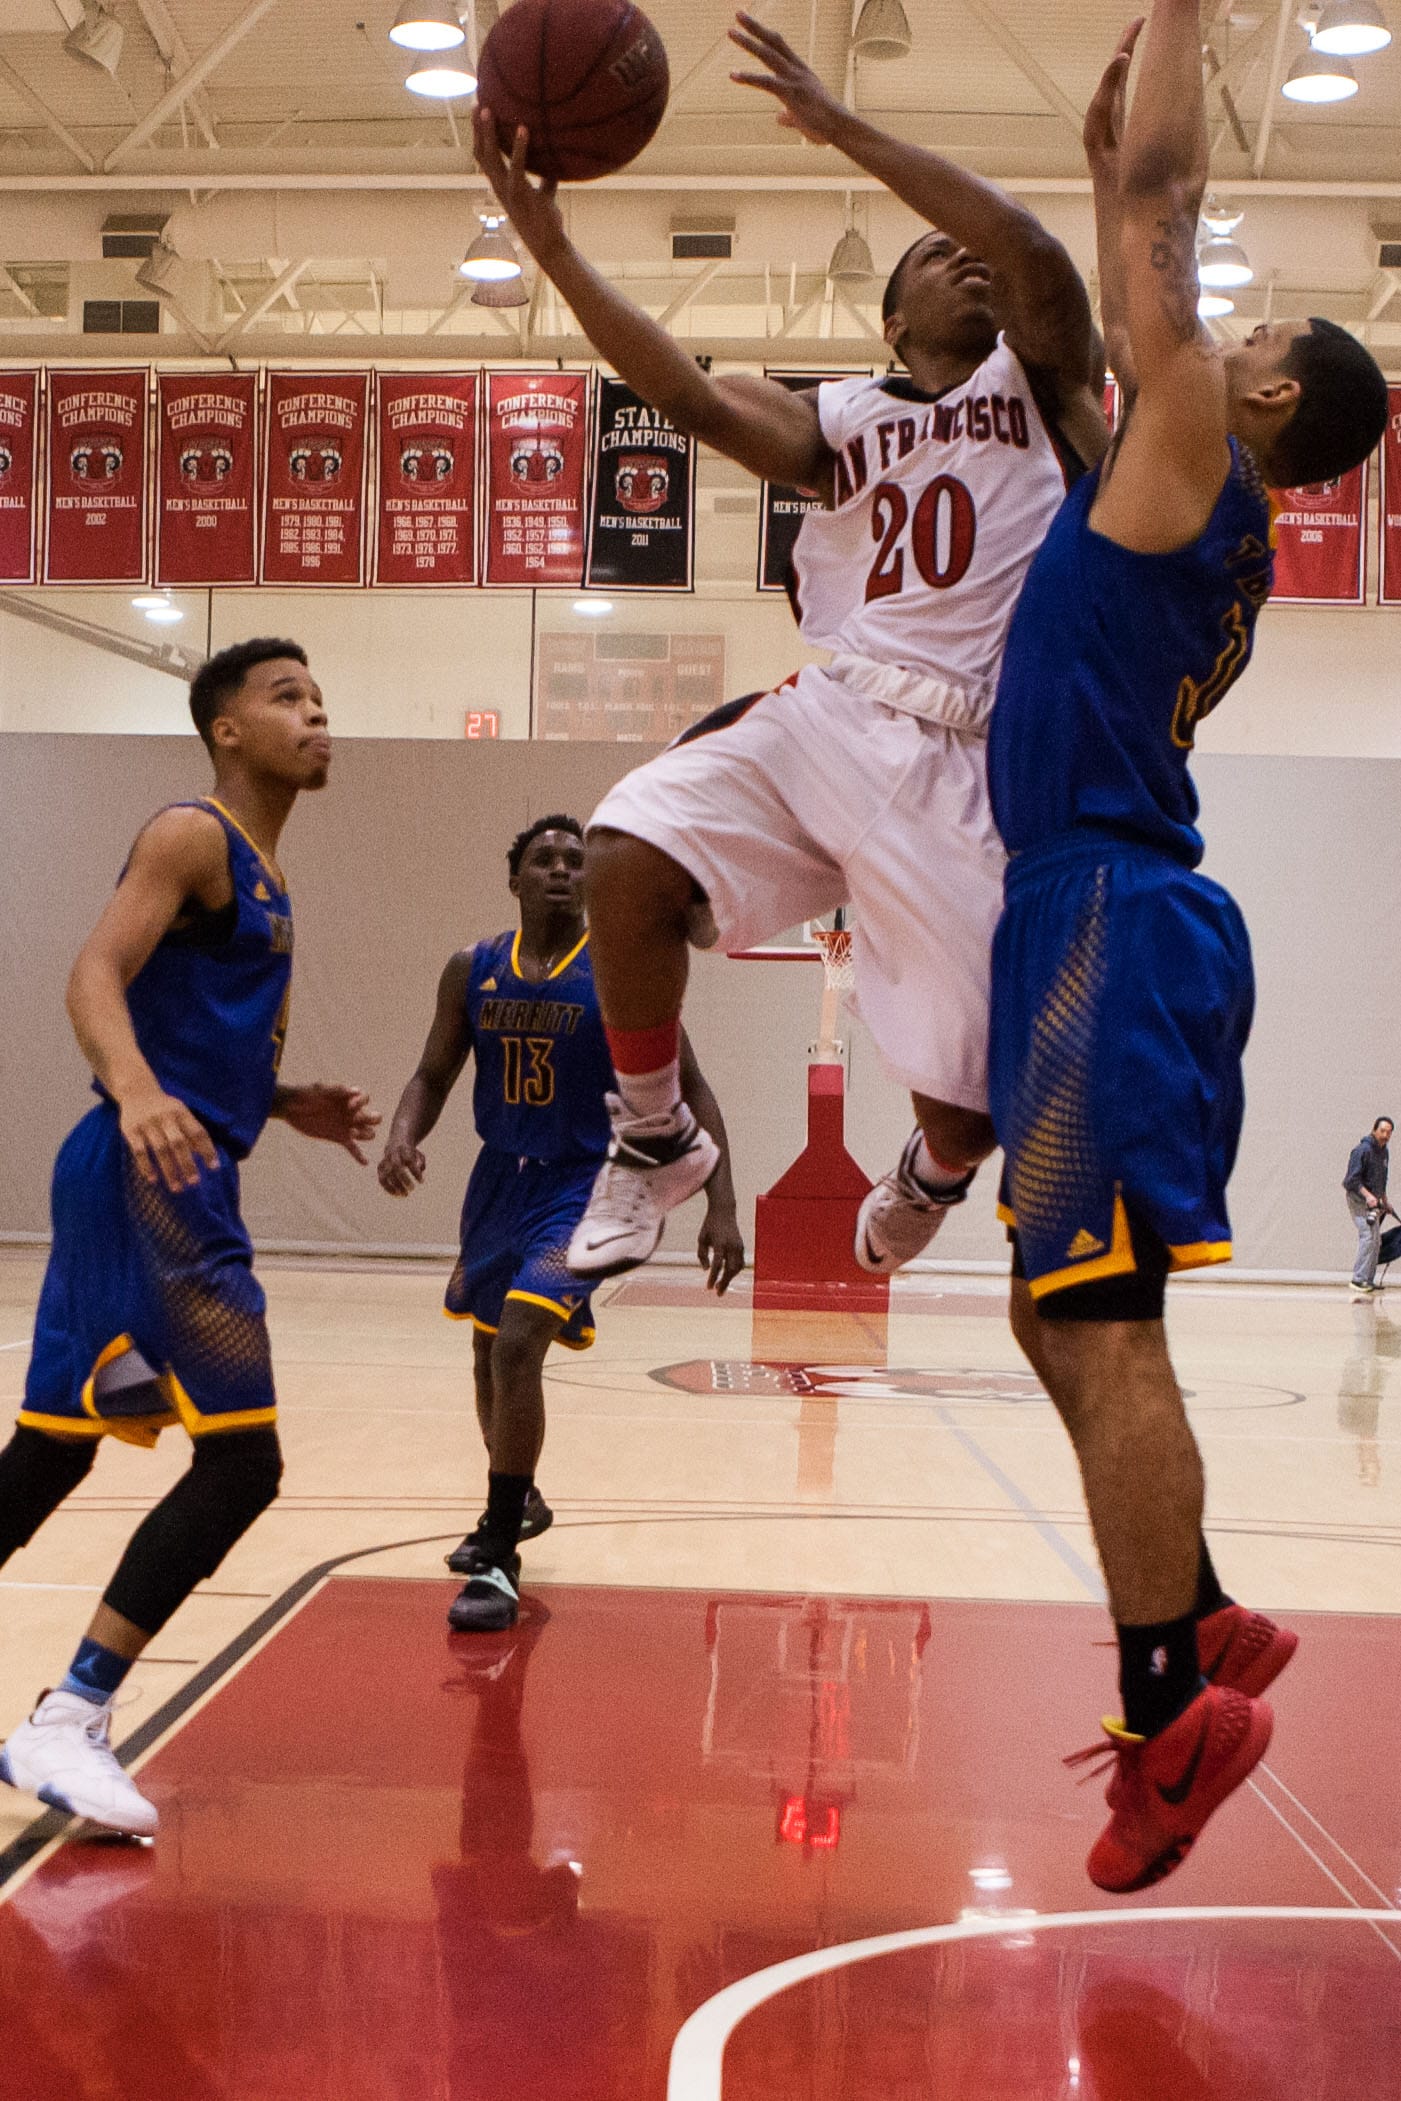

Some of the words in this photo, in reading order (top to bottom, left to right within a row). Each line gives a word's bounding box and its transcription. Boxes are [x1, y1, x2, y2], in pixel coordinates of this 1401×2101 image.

[58, 392, 138, 414] CONFERENCE
[167, 394, 247, 416] CONFERENCE
[277, 393, 358, 416] CONFERENCE
[387, 393, 468, 416] CONFERENCE
[497, 393, 578, 416] CONFERENCE
[62, 407, 133, 427] CHAMPIONS
[171, 410, 243, 429] CHAMPIONS
[281, 409, 353, 429] CHAMPIONS
[391, 410, 464, 430] CHAMPIONS
[501, 409, 574, 430] CHAMPIONS
[601, 429, 687, 454] CHAMPIONS
[834, 433, 868, 509] AN
[55, 497, 80, 509] MEN'S
[81, 497, 138, 508] BASKETBALL
[166, 499, 191, 511] MEN'S
[191, 498, 248, 511] BASKETBALL
[272, 498, 298, 510] MEN'S
[298, 498, 355, 511] BASKETBALL
[385, 499, 411, 511] MEN'S
[411, 499, 468, 511] BASKETBALL
[495, 499, 520, 511] MEN'S
[521, 499, 578, 511] BASKETBALL
[773, 501, 799, 514] MEN'S
[599, 515, 625, 529] MEN'S
[625, 517, 683, 530] BASKETBALL
[1303, 512, 1359, 526] BASKETBALL
[631, 534, 649, 546] 2011
[864, 473, 977, 606] 20
[467, 712, 498, 739] 27
[479, 998, 585, 1035] MERRITT
[500, 1036, 555, 1106] 13
